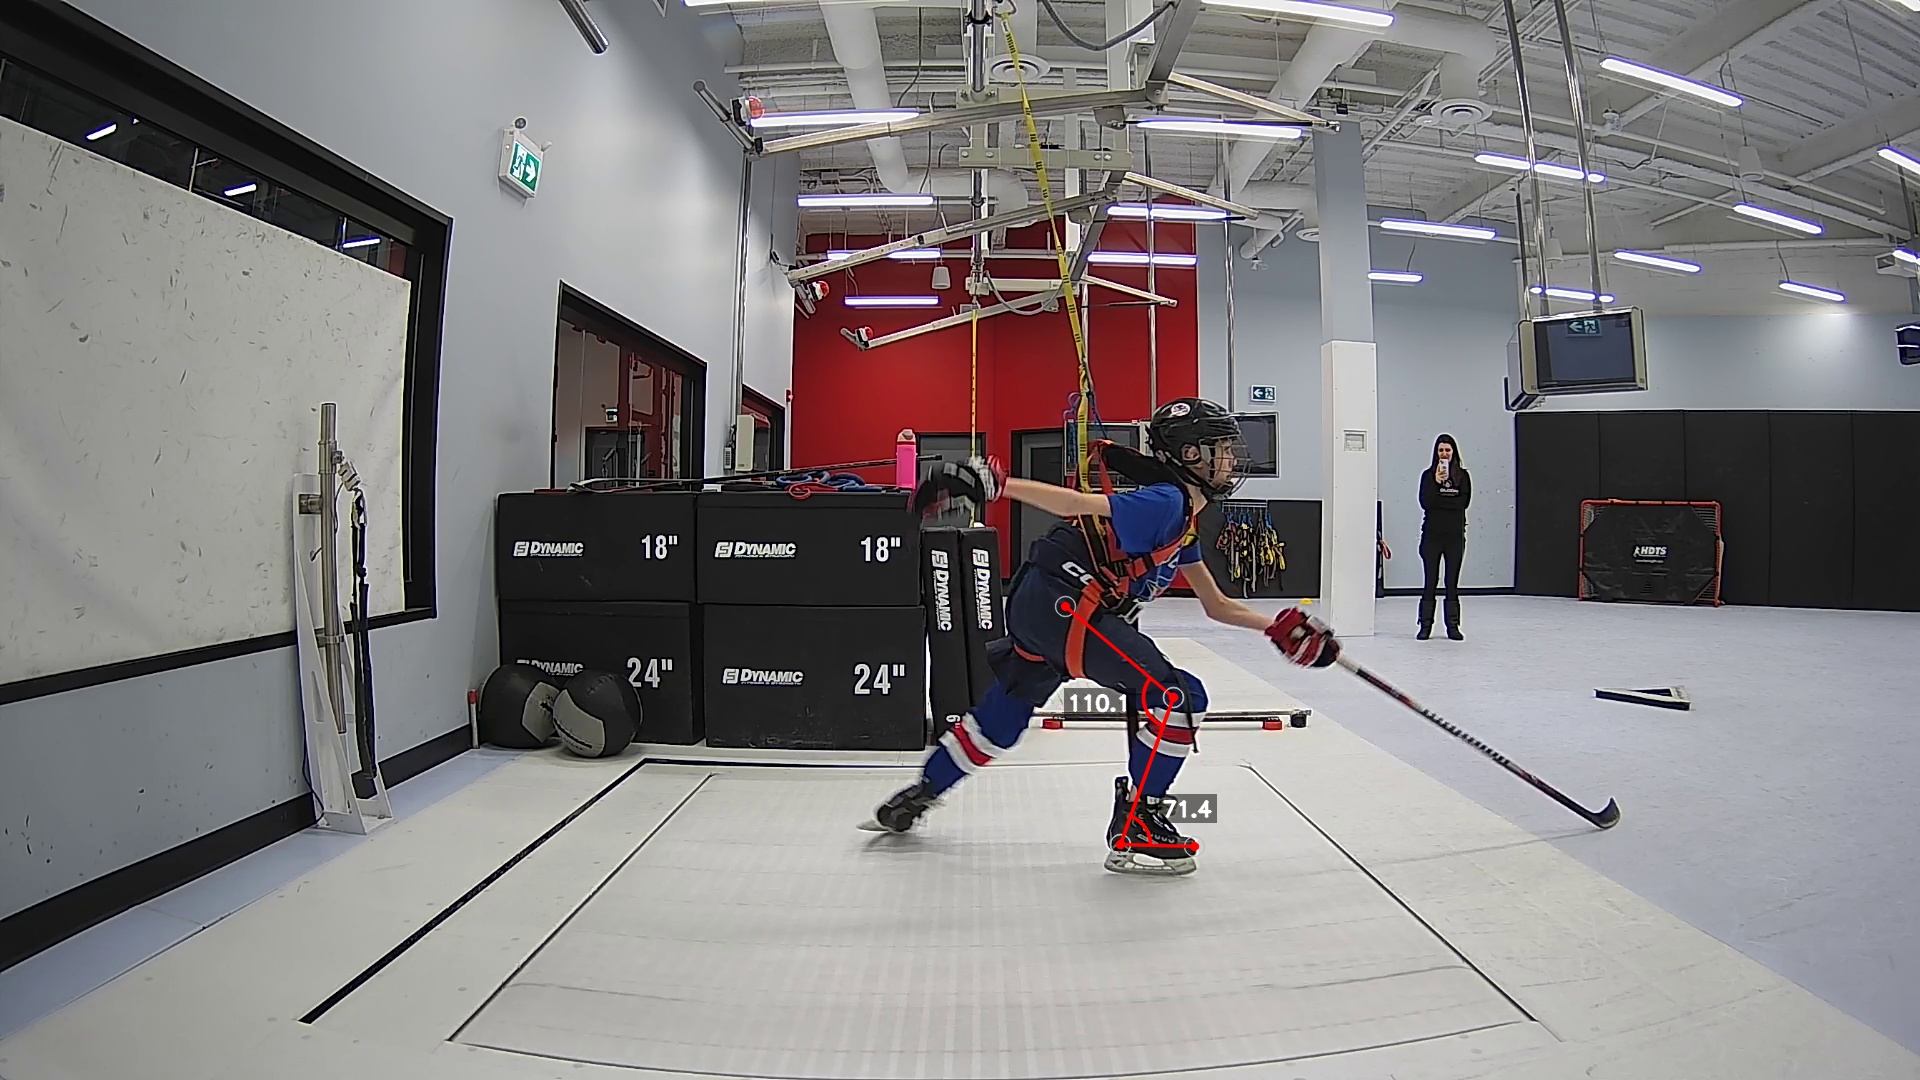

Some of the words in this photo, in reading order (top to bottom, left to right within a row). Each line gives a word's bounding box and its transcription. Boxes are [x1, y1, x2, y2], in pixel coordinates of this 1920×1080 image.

[530, 541, 584, 554] DYNAMIC
[641, 534, 678, 559] 18"
[734, 541, 797, 555] DYNAMIC
[860, 536, 901, 562] 18"
[1640, 546, 1667, 555] HDTS
[936, 569, 952, 631] DYNAMIC
[976, 568, 993, 630] DYNAMIC
[627, 657, 673, 688] 24"
[740, 668, 804, 683] DYNAMIC
[854, 663, 905, 695] 24"
